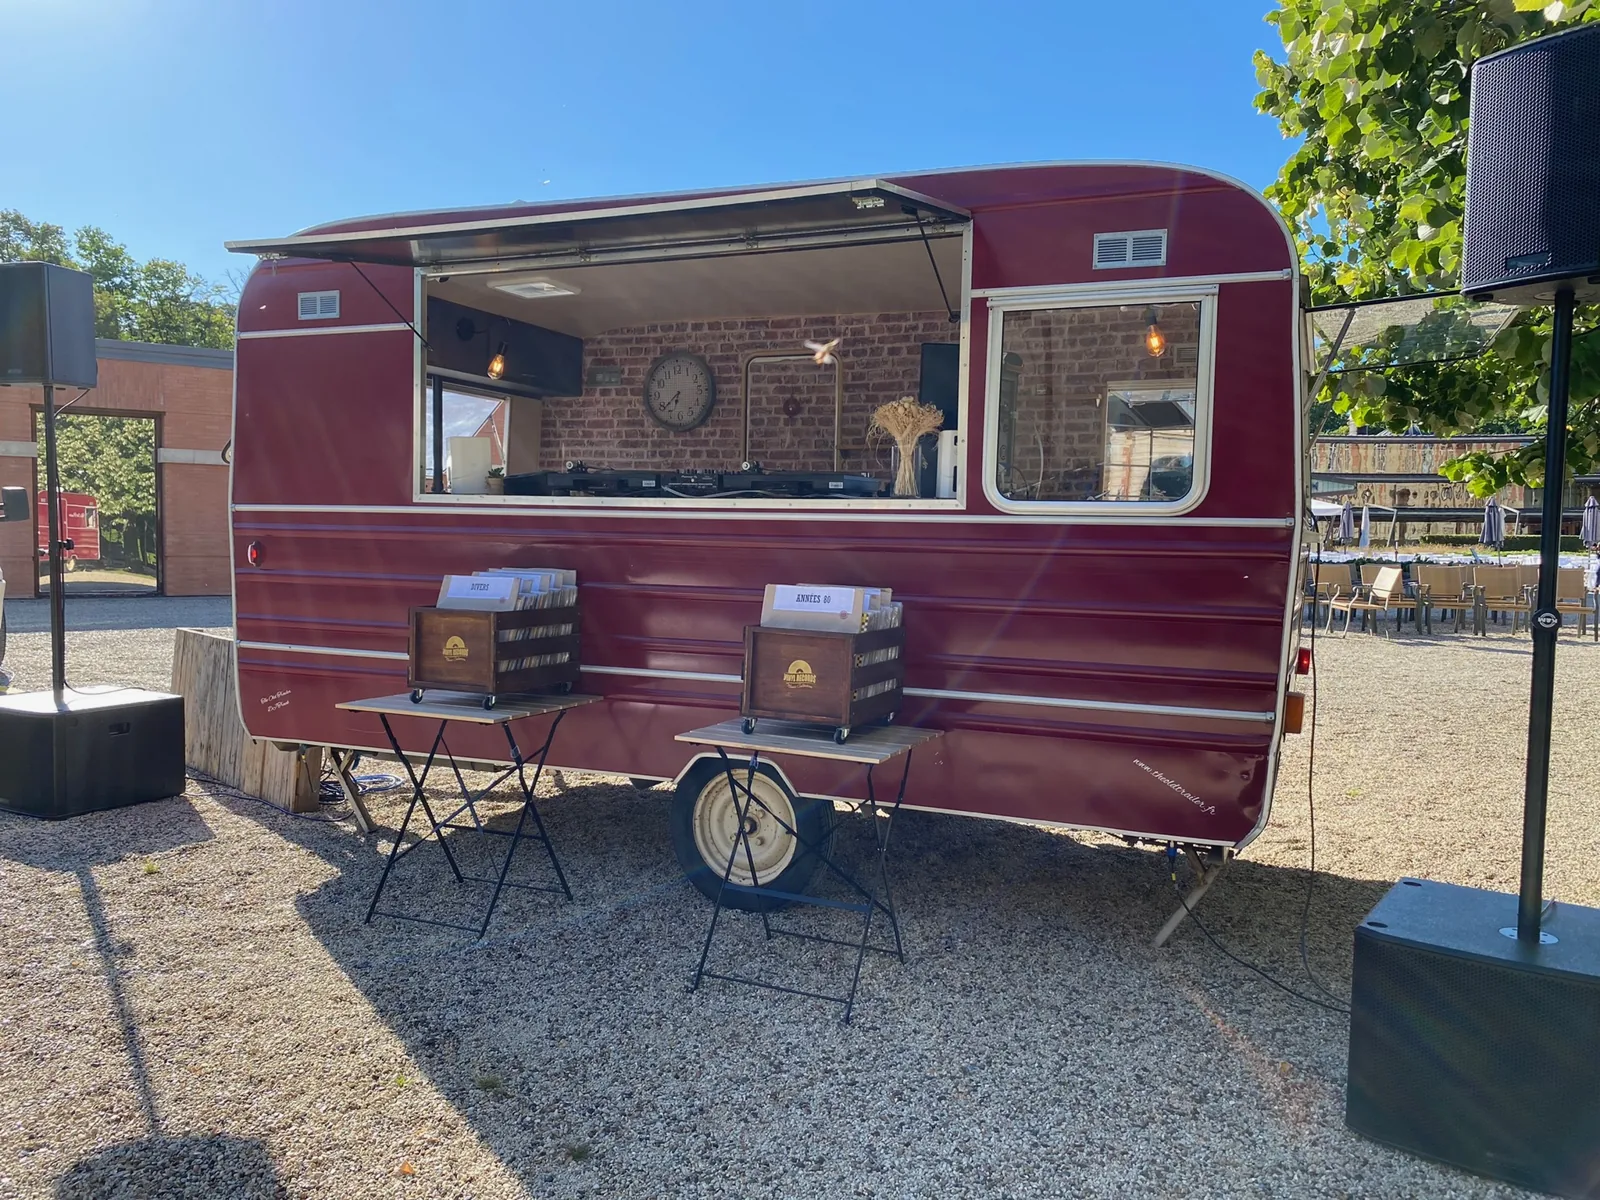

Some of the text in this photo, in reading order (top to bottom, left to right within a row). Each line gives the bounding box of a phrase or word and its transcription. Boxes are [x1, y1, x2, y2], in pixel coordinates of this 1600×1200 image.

[664, 370, 671, 379] 11
[673, 365, 681, 375] 12
[657, 378, 665, 388] 10
[692, 374, 698, 383] 2
[653, 391, 660, 400] 9
[659, 401, 666, 411] 8
[687, 406, 694, 416] 5
[677, 411, 683, 420] 6
[470, 583, 490, 591] DIVERS
[795, 593, 831, 604] ANNÉES 80
[796, 673, 817, 684] RECORDS
[1132, 758, 1216, 816] www.theoldtrailer.fr
